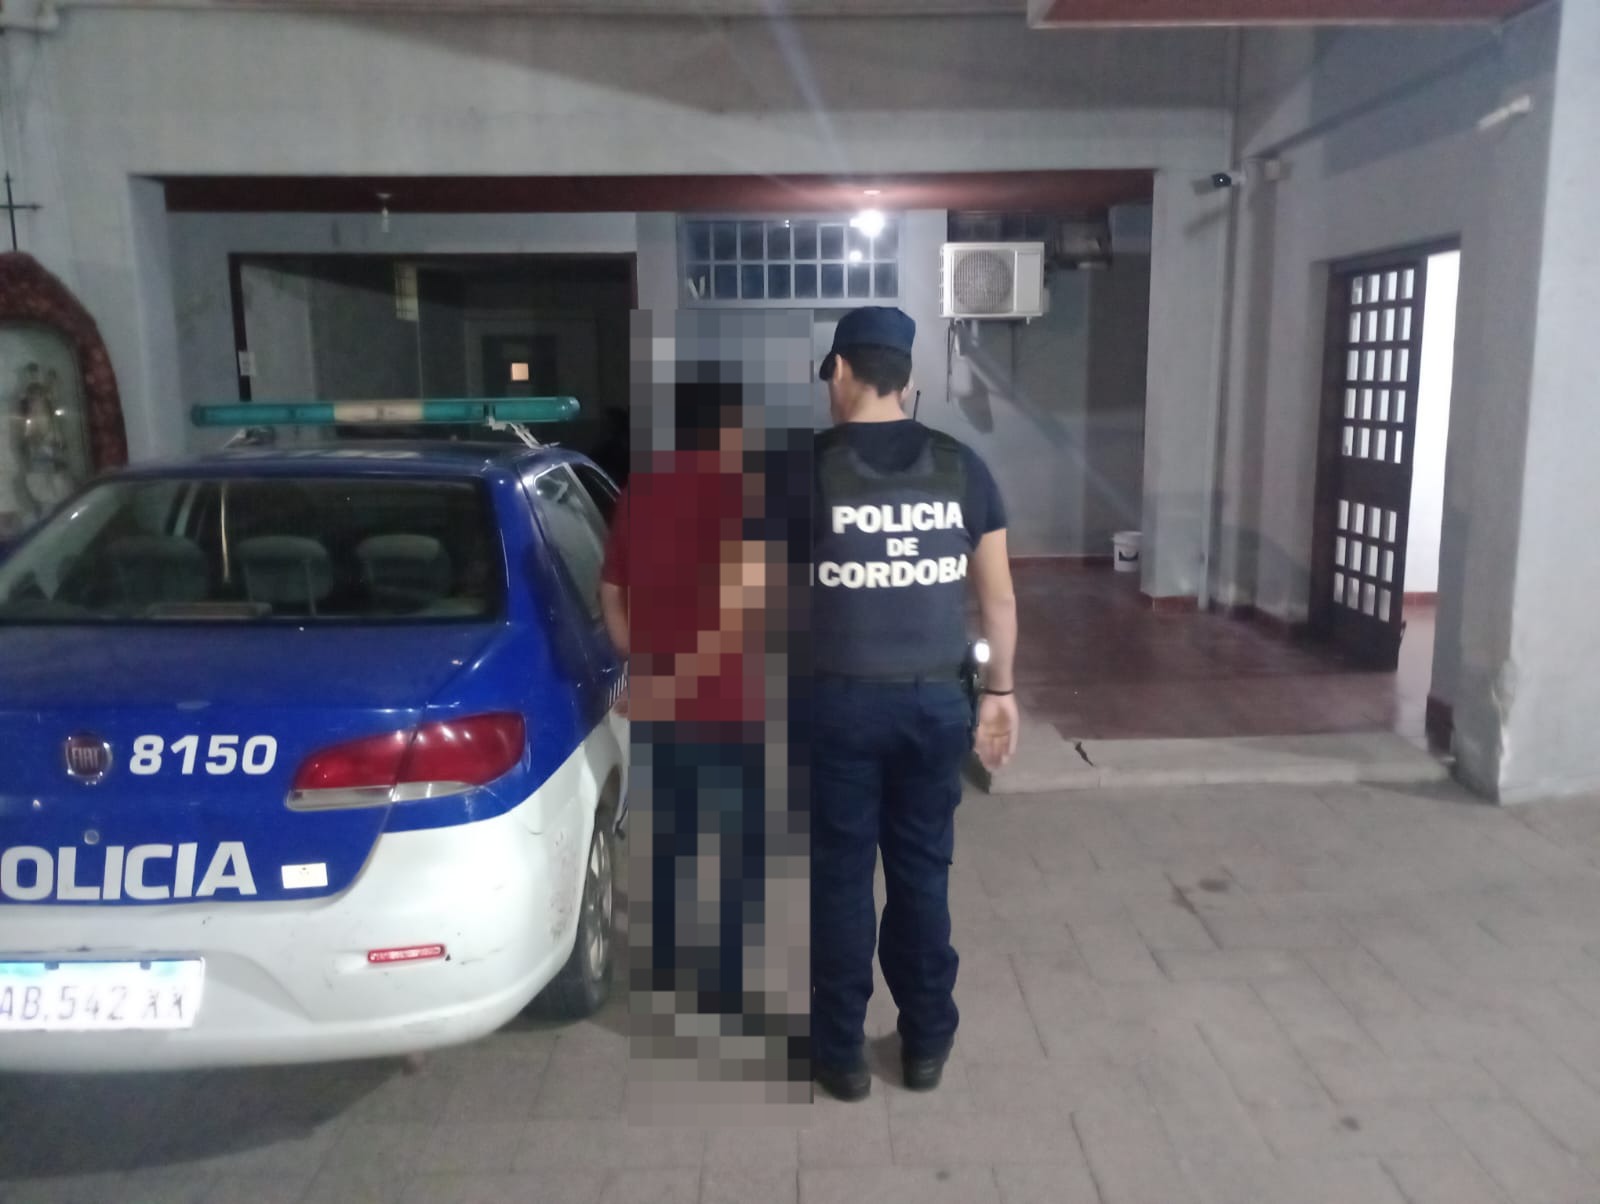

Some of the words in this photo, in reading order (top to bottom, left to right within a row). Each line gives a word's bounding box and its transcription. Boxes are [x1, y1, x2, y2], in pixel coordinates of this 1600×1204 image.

[832, 501, 964, 533] POLICIA
[886, 537, 920, 557] DE
[818, 553, 968, 589] CORDOBA
[71, 747, 100, 768] FIAT
[129, 734, 278, 775] 8150
